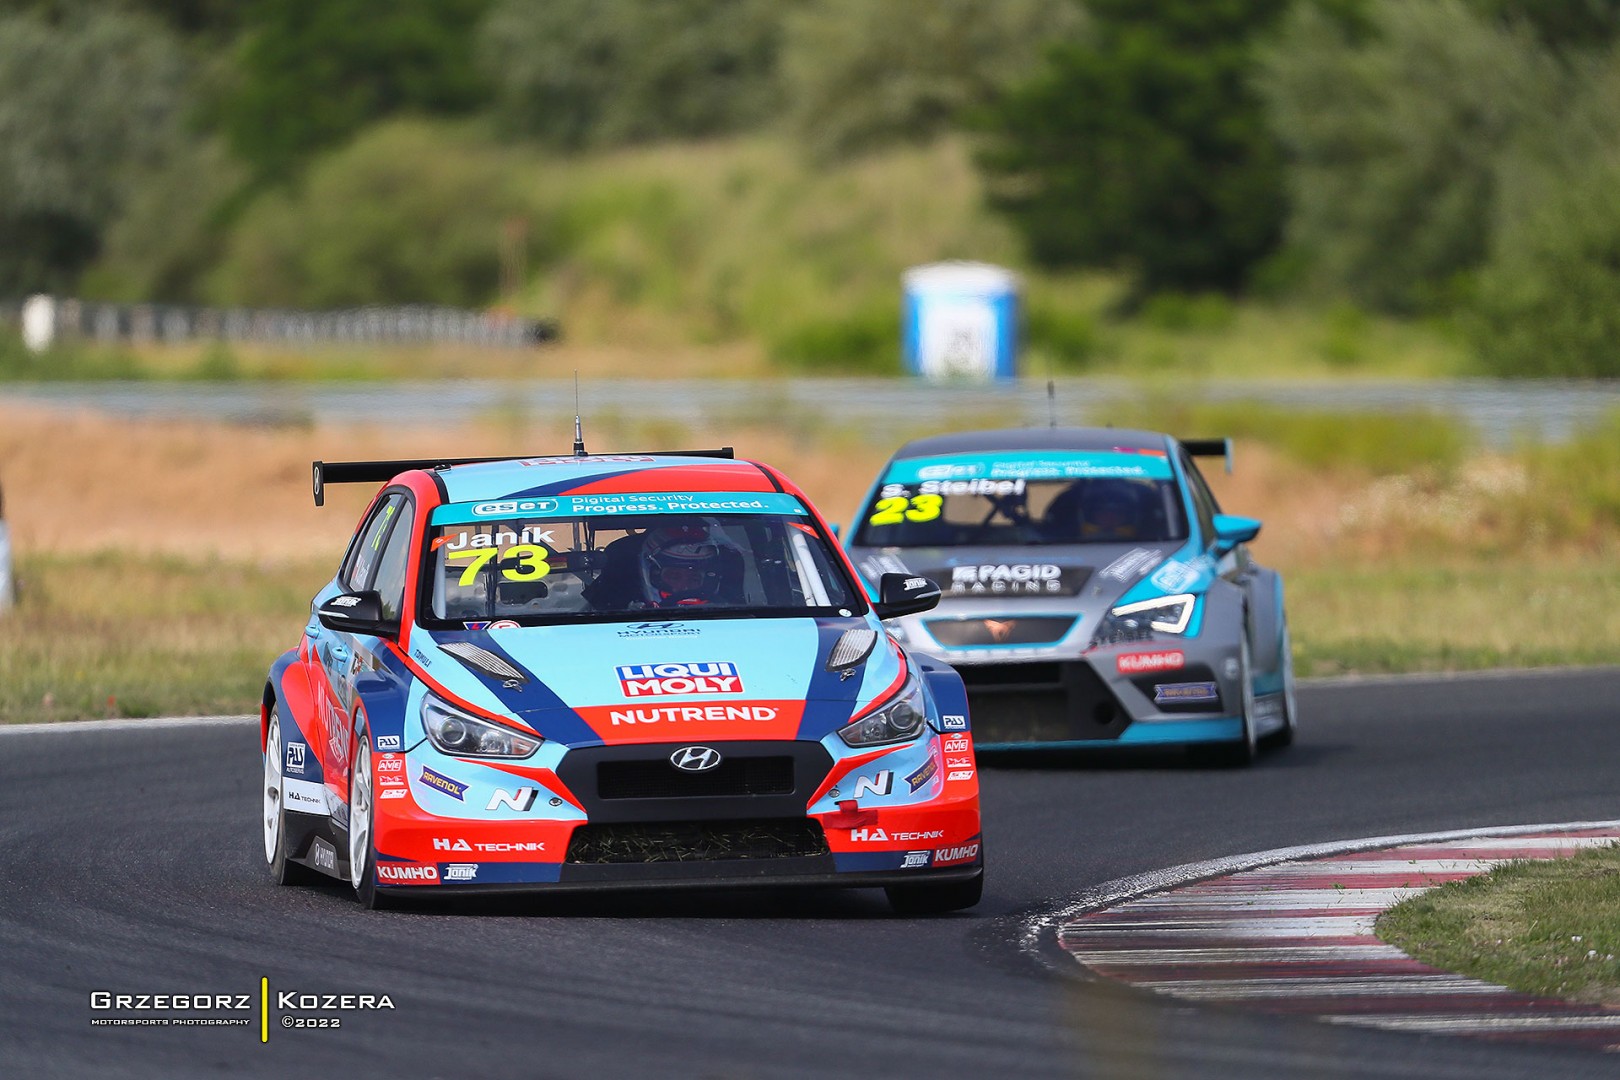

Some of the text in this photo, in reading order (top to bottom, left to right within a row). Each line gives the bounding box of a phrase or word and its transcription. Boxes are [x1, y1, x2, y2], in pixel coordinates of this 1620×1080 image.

[918, 479, 1026, 495] Steibel
[572, 494, 693, 505] Digital Security
[573, 500, 769, 513] Progress. Protected.
[870, 494, 943, 525] 23
[446, 527, 555, 550] Janík
[448, 544, 551, 587] 73
[978, 564, 1061, 581] PAGID
[951, 580, 1062, 593] RACING
[620, 662, 733, 680] LIQUI
[624, 676, 738, 696] MOLY
[609, 706, 777, 726] NUTREND
[423, 771, 461, 795] RAVENOL
[851, 828, 944, 842] HA TECHNIK
[433, 838, 545, 852] HA TECHNIK
[934, 844, 979, 862] KUMHO
[377, 865, 438, 880] KUMHO
